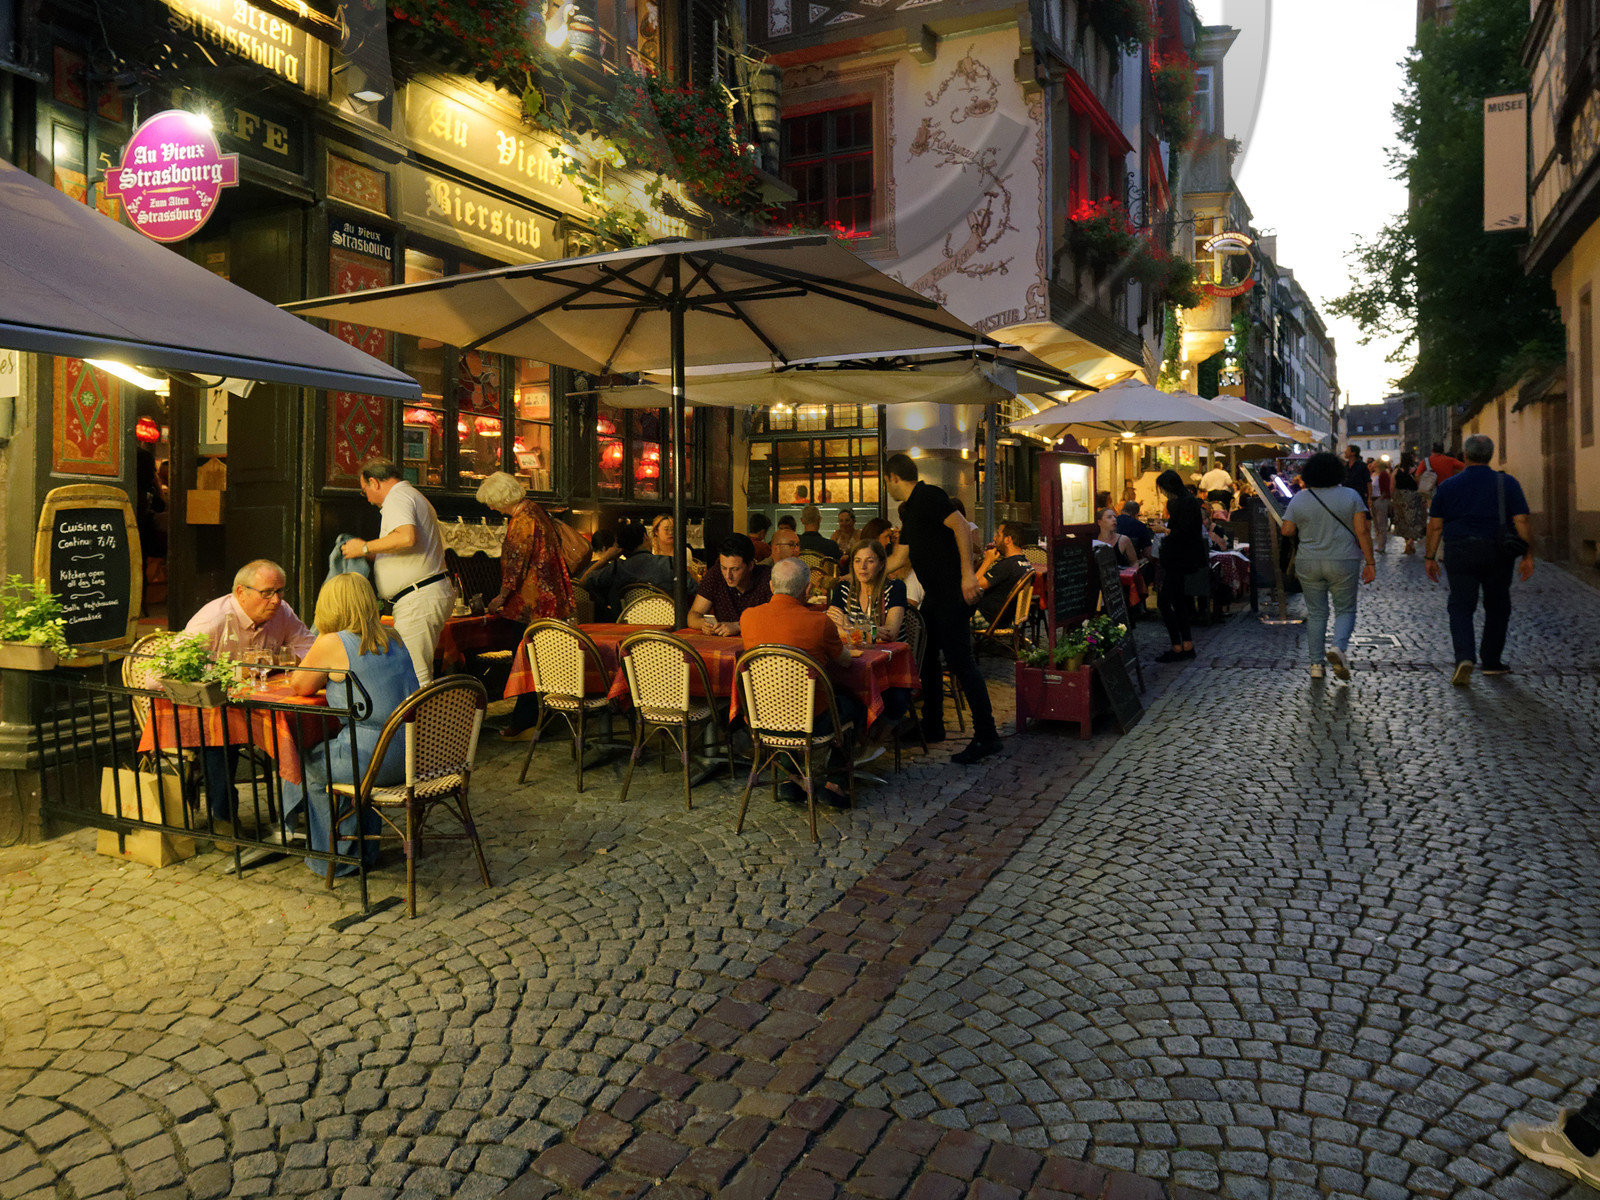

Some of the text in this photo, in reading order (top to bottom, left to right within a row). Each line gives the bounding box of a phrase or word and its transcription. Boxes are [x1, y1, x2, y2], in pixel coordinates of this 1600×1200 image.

[231, 0, 293, 47] Alten
[1487, 100, 1524, 112] MUSEE
[428, 100, 469, 148] Au
[133, 142, 206, 165] Au Vieux
[929, 130, 980, 160] Restaurant
[118, 163, 224, 191] Strasbourg
[149, 195, 190, 209] Zum Alten
[425, 176, 541, 250] Bierstub
[136, 207, 203, 225] Strassburg
[343, 222, 355, 234] Au
[331, 230, 392, 261] Strasbourg
[973, 308, 1020, 332] INSTUB
[60, 522, 113, 534] Cuisine en
[60, 570, 105, 581] Kitchen open
[67, 579, 77, 588] all
[78, 579, 91, 589] day
